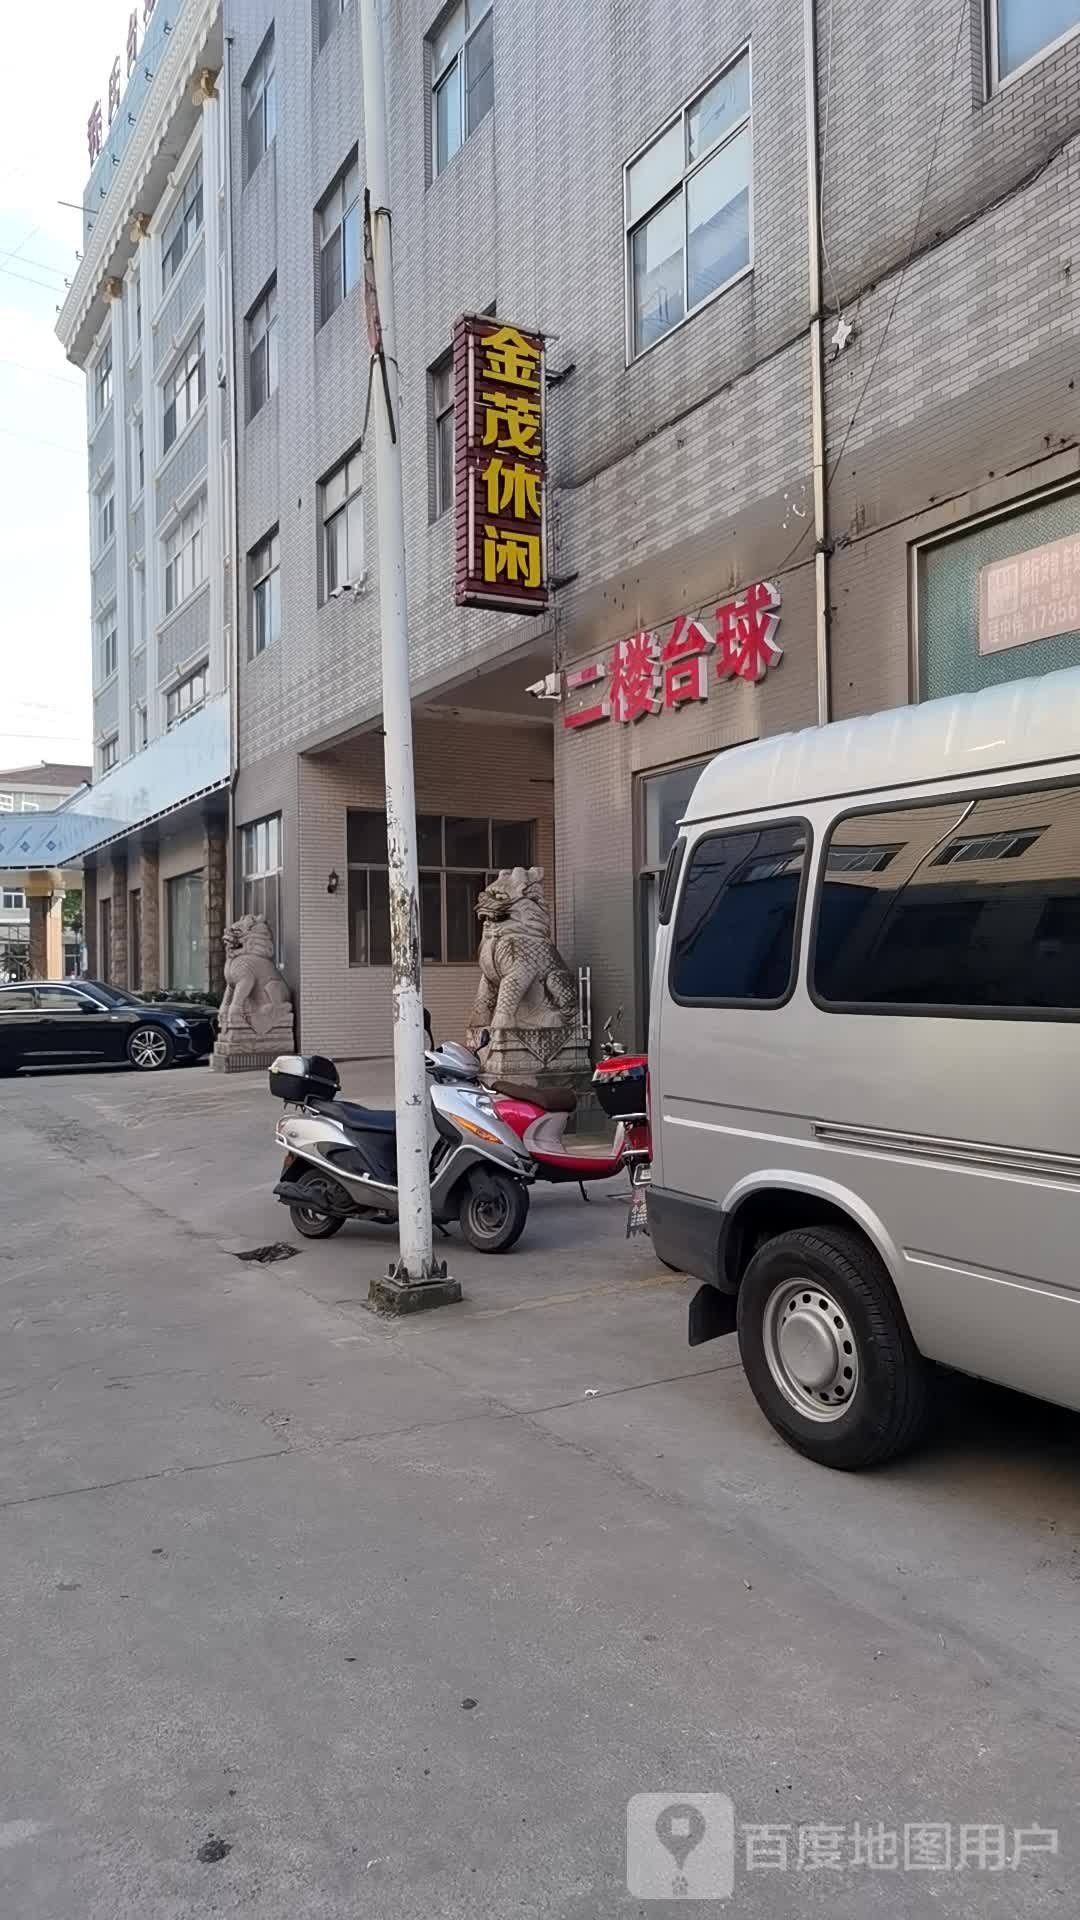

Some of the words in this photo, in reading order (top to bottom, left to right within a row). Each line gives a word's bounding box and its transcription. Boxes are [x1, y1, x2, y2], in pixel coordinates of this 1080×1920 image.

[482, 326, 541, 587] 金茂休闲
[564, 582, 782, 729] 二楼台球
